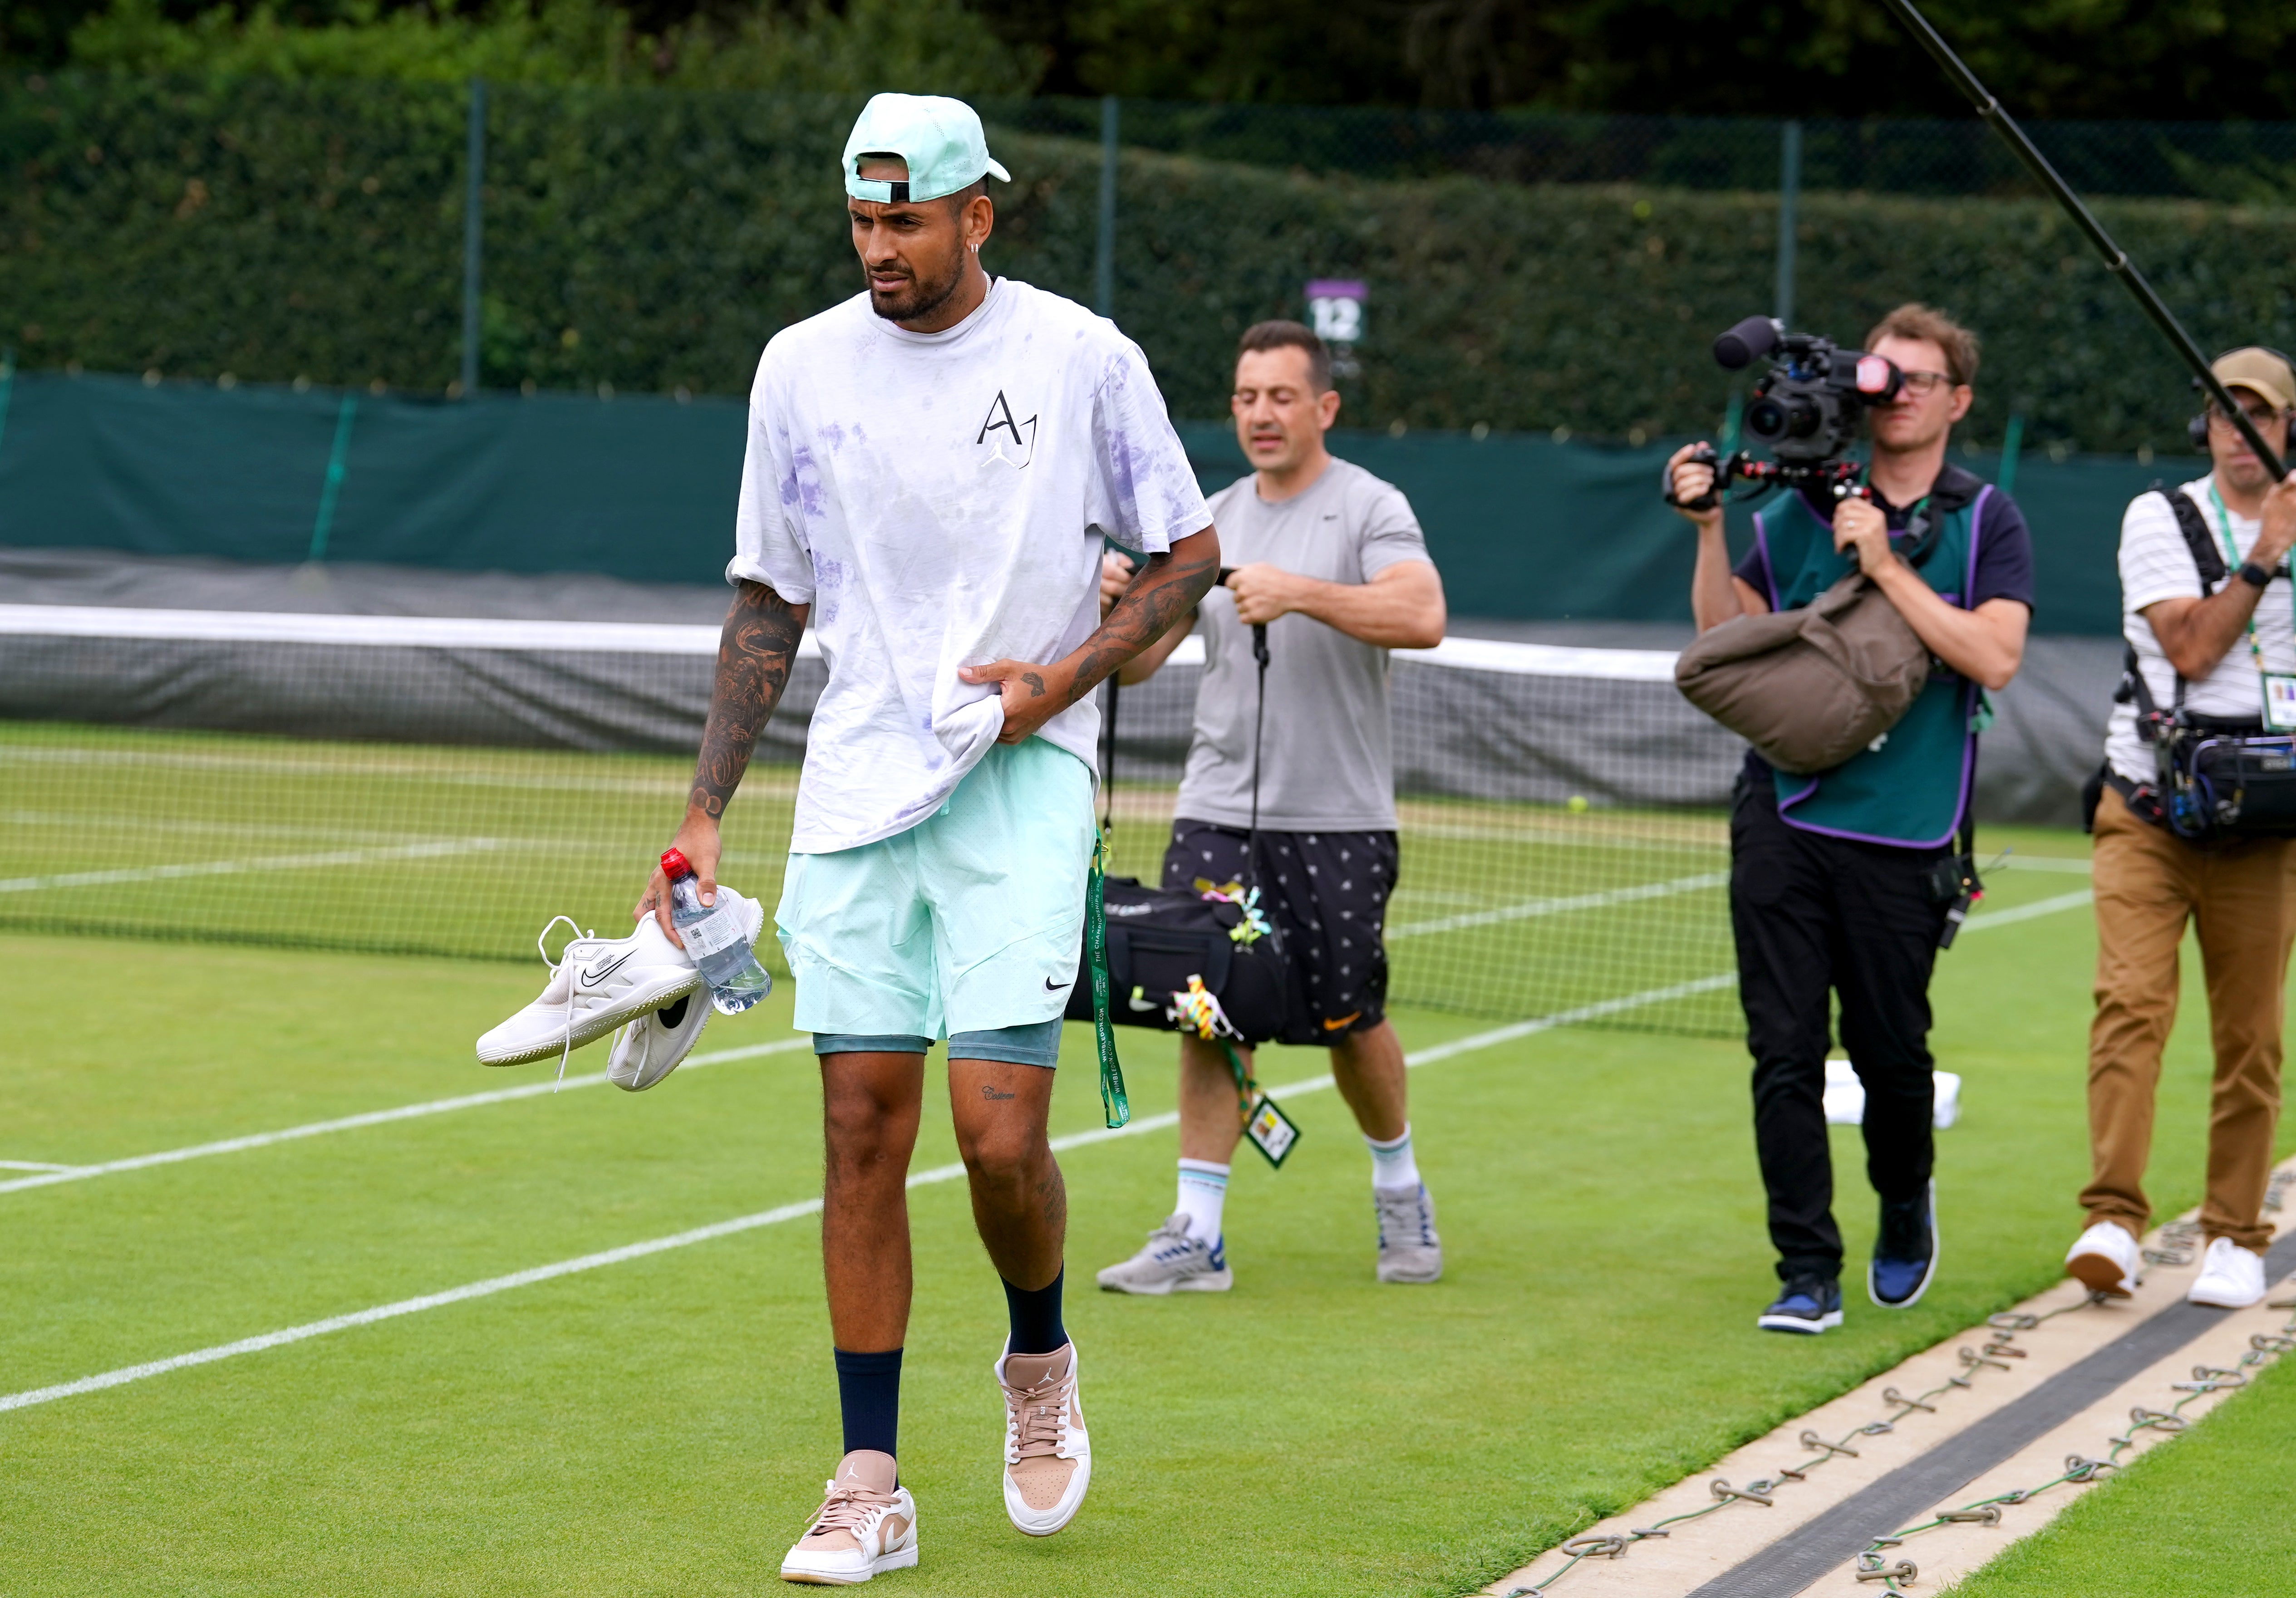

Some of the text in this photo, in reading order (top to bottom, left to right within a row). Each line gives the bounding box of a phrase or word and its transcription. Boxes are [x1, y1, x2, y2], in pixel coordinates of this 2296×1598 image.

[1309, 296, 1361, 341] 12
[1099, 1008, 1107, 1063] WIMBLEDON.COM
[1108, 1041, 1120, 1093] WIMBLEDON.COM
